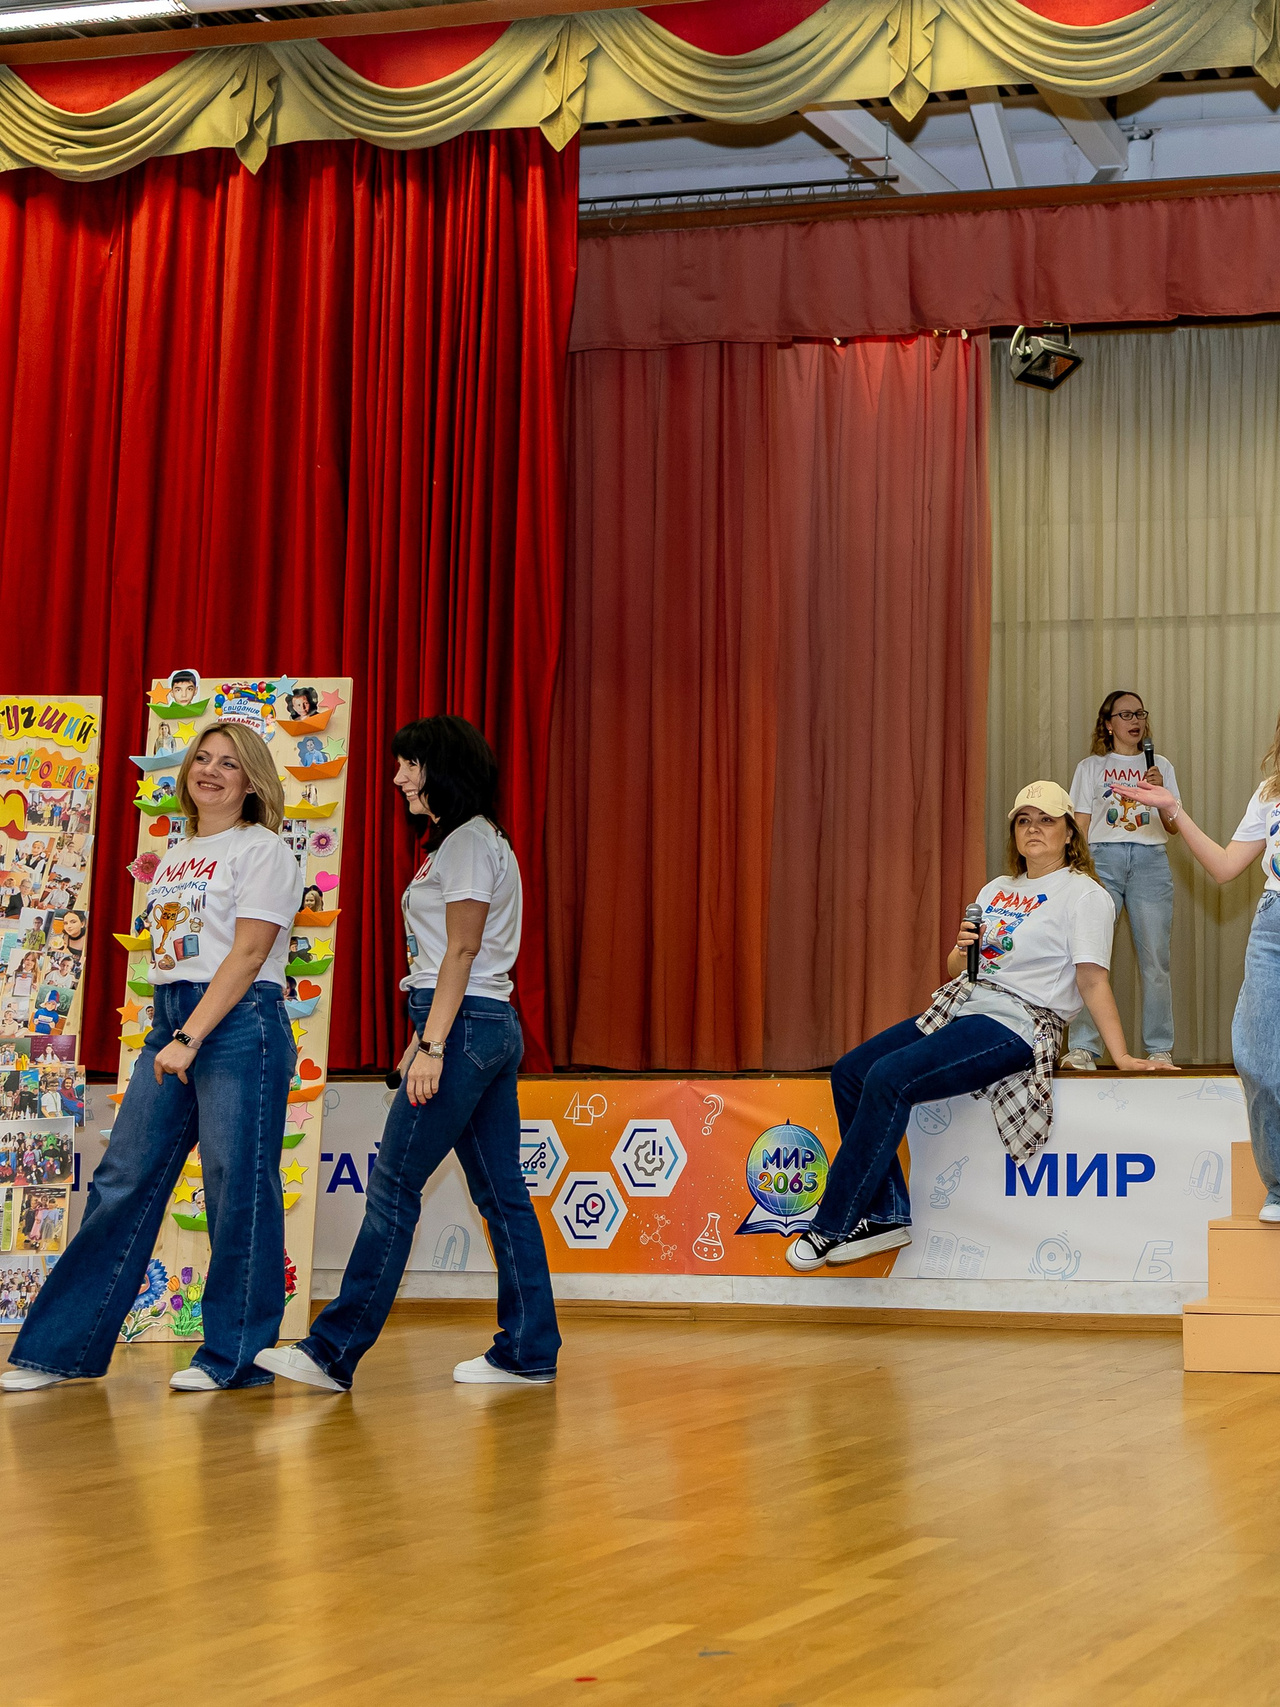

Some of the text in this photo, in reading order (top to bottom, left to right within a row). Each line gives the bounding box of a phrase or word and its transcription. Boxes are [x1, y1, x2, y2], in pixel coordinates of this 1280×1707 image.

[15, 754, 53, 781] ПРО
[155, 856, 218, 885] МАМА
[762, 1147, 816, 1170] МИР
[758, 1171, 819, 1194] 2065
[1005, 1152, 1156, 1198] МИР
